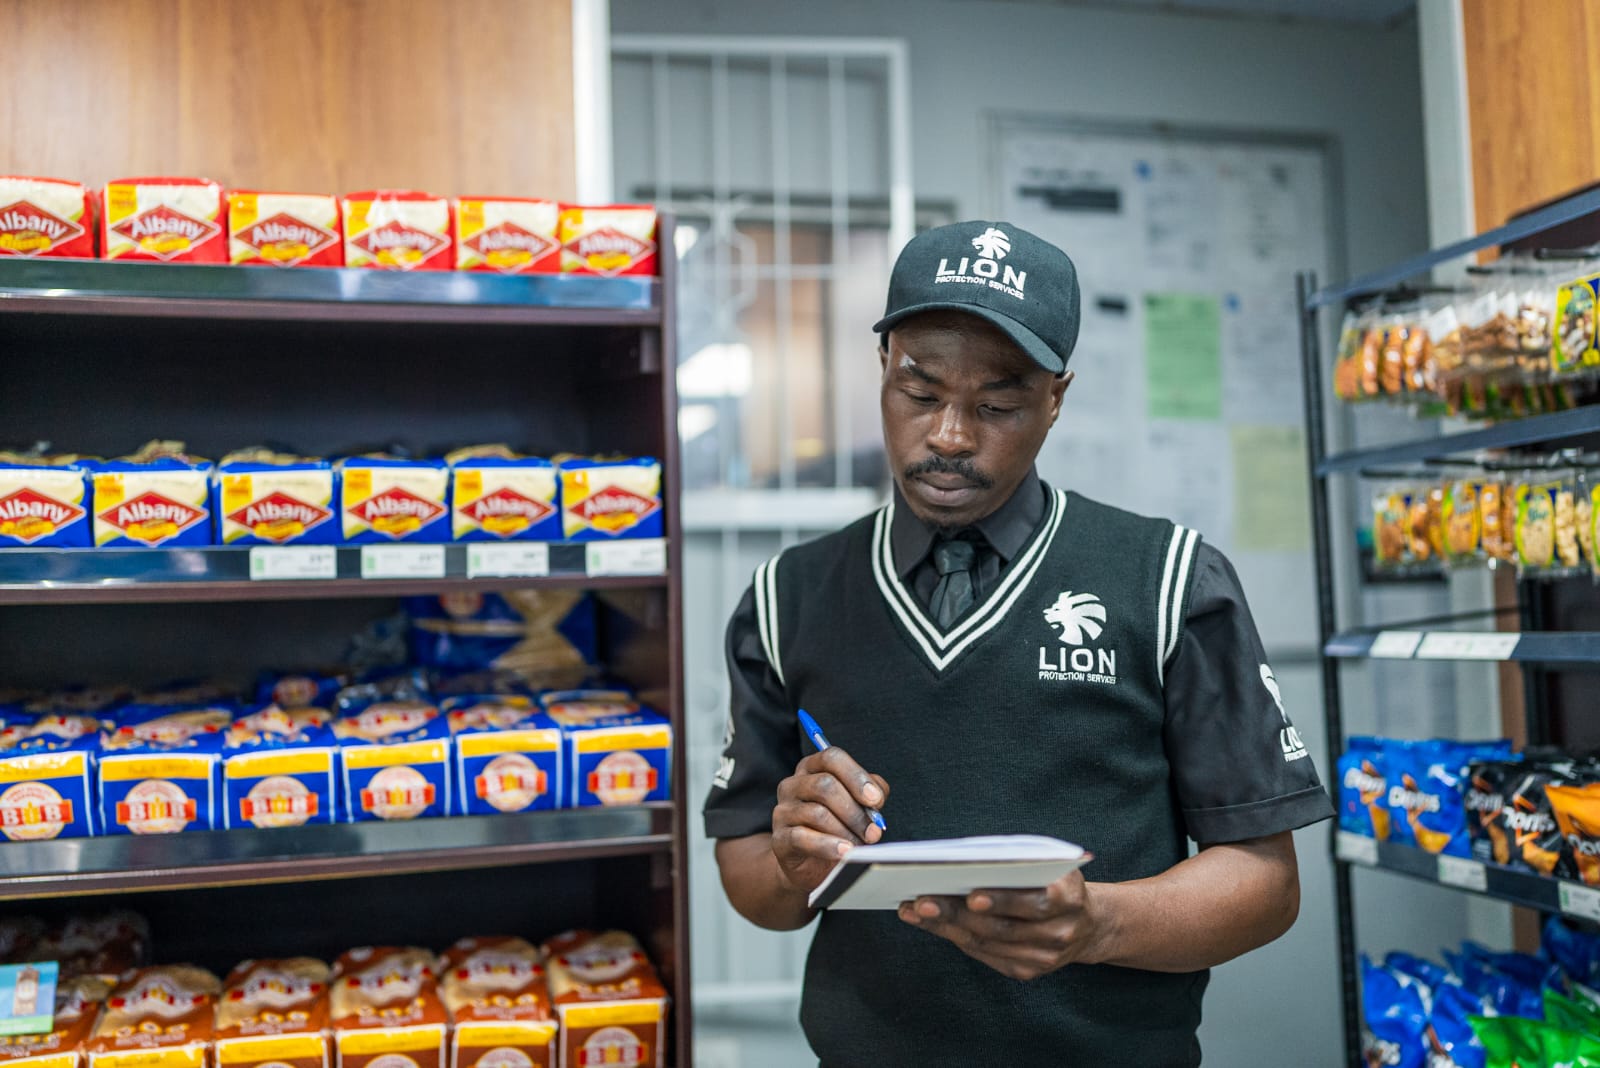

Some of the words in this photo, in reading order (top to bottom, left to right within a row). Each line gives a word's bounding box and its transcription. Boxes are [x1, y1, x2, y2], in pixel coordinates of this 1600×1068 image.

[131, 211, 203, 239] Albany
[251, 222, 323, 246] Albany
[936, 257, 1027, 291] LION
[934, 276, 987, 284] PROTECTION
[988, 280, 1025, 299] SERVICES
[117, 500, 194, 526] Albany
[245, 502, 318, 525] Albany
[365, 498, 435, 518] Albany
[474, 498, 543, 518] Albany
[1039, 646, 1116, 675] LION
[1038, 671, 1085, 681] PROTECTION
